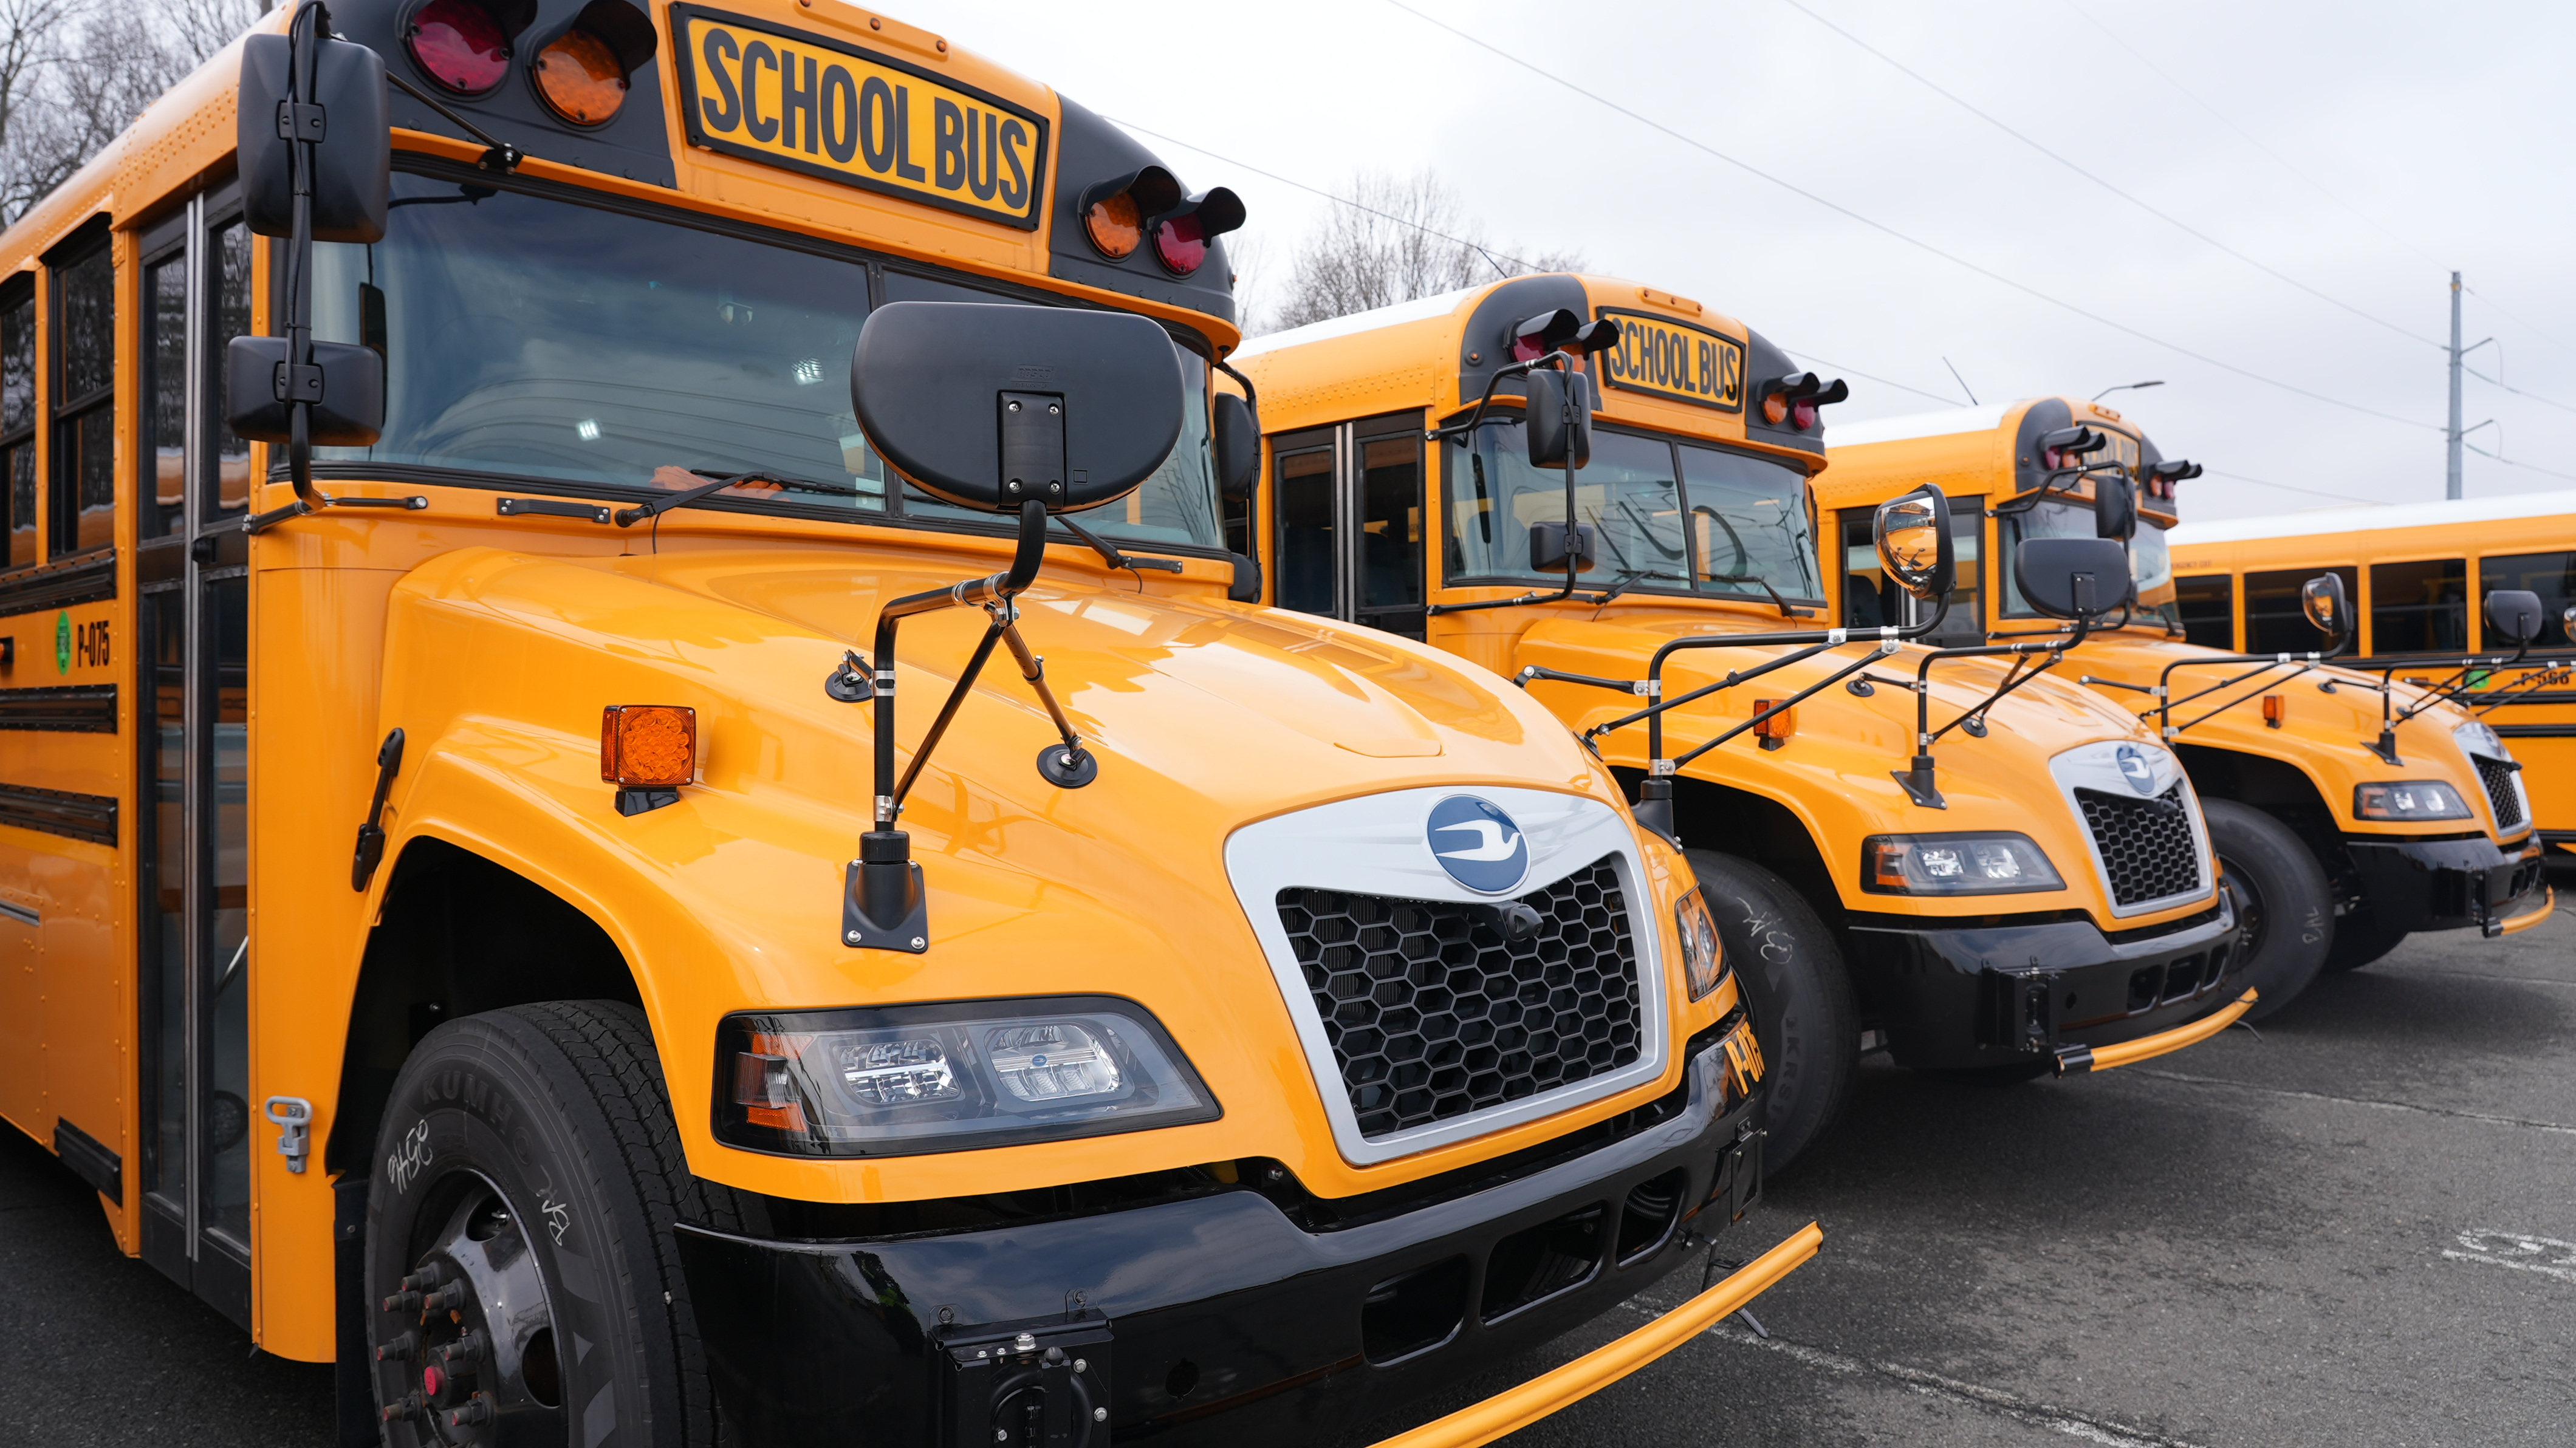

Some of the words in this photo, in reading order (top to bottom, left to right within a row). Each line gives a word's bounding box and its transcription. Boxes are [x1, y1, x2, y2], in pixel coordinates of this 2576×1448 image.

[702, 27, 925, 183] SCHOOL
[934, 96, 1028, 210] BUS
[1611, 317, 1696, 392] SCHOOL
[1699, 339, 1737, 401] BUS
[78, 620, 110, 668] P-075
[1724, 1021, 1765, 1095] P-075
[422, 1070, 533, 1167] KUMHO
